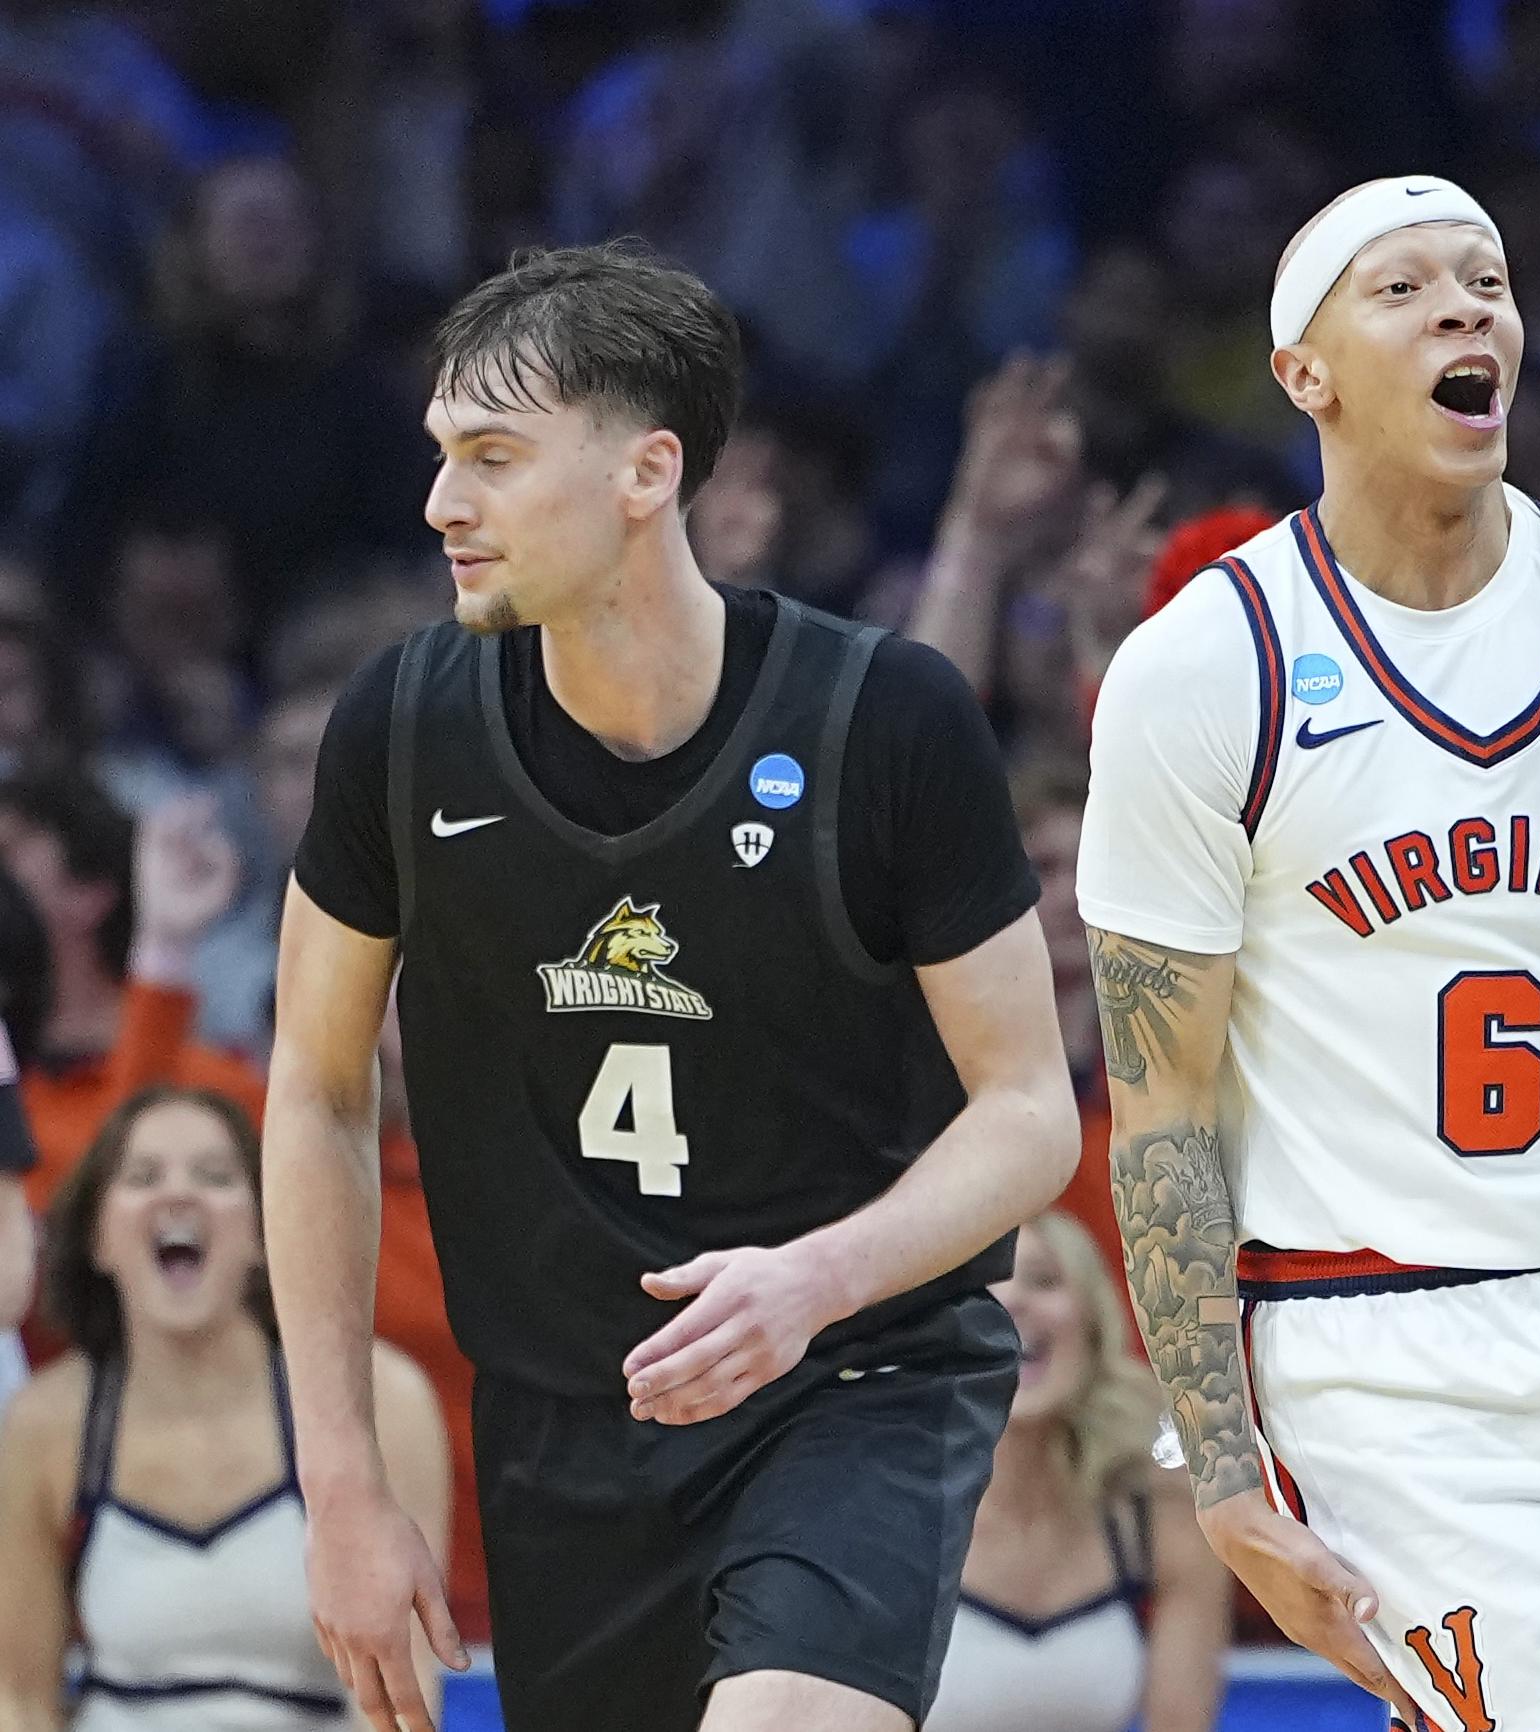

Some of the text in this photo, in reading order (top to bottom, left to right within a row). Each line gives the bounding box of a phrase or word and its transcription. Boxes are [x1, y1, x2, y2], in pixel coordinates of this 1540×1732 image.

[1296, 674, 1340, 693] NCAA
[756, 778, 800, 798] NCAA
[546, 968, 710, 1016] WRIGHT STATE
[578, 1043, 690, 1198] 4
[1404, 1606, 1496, 1732] V
